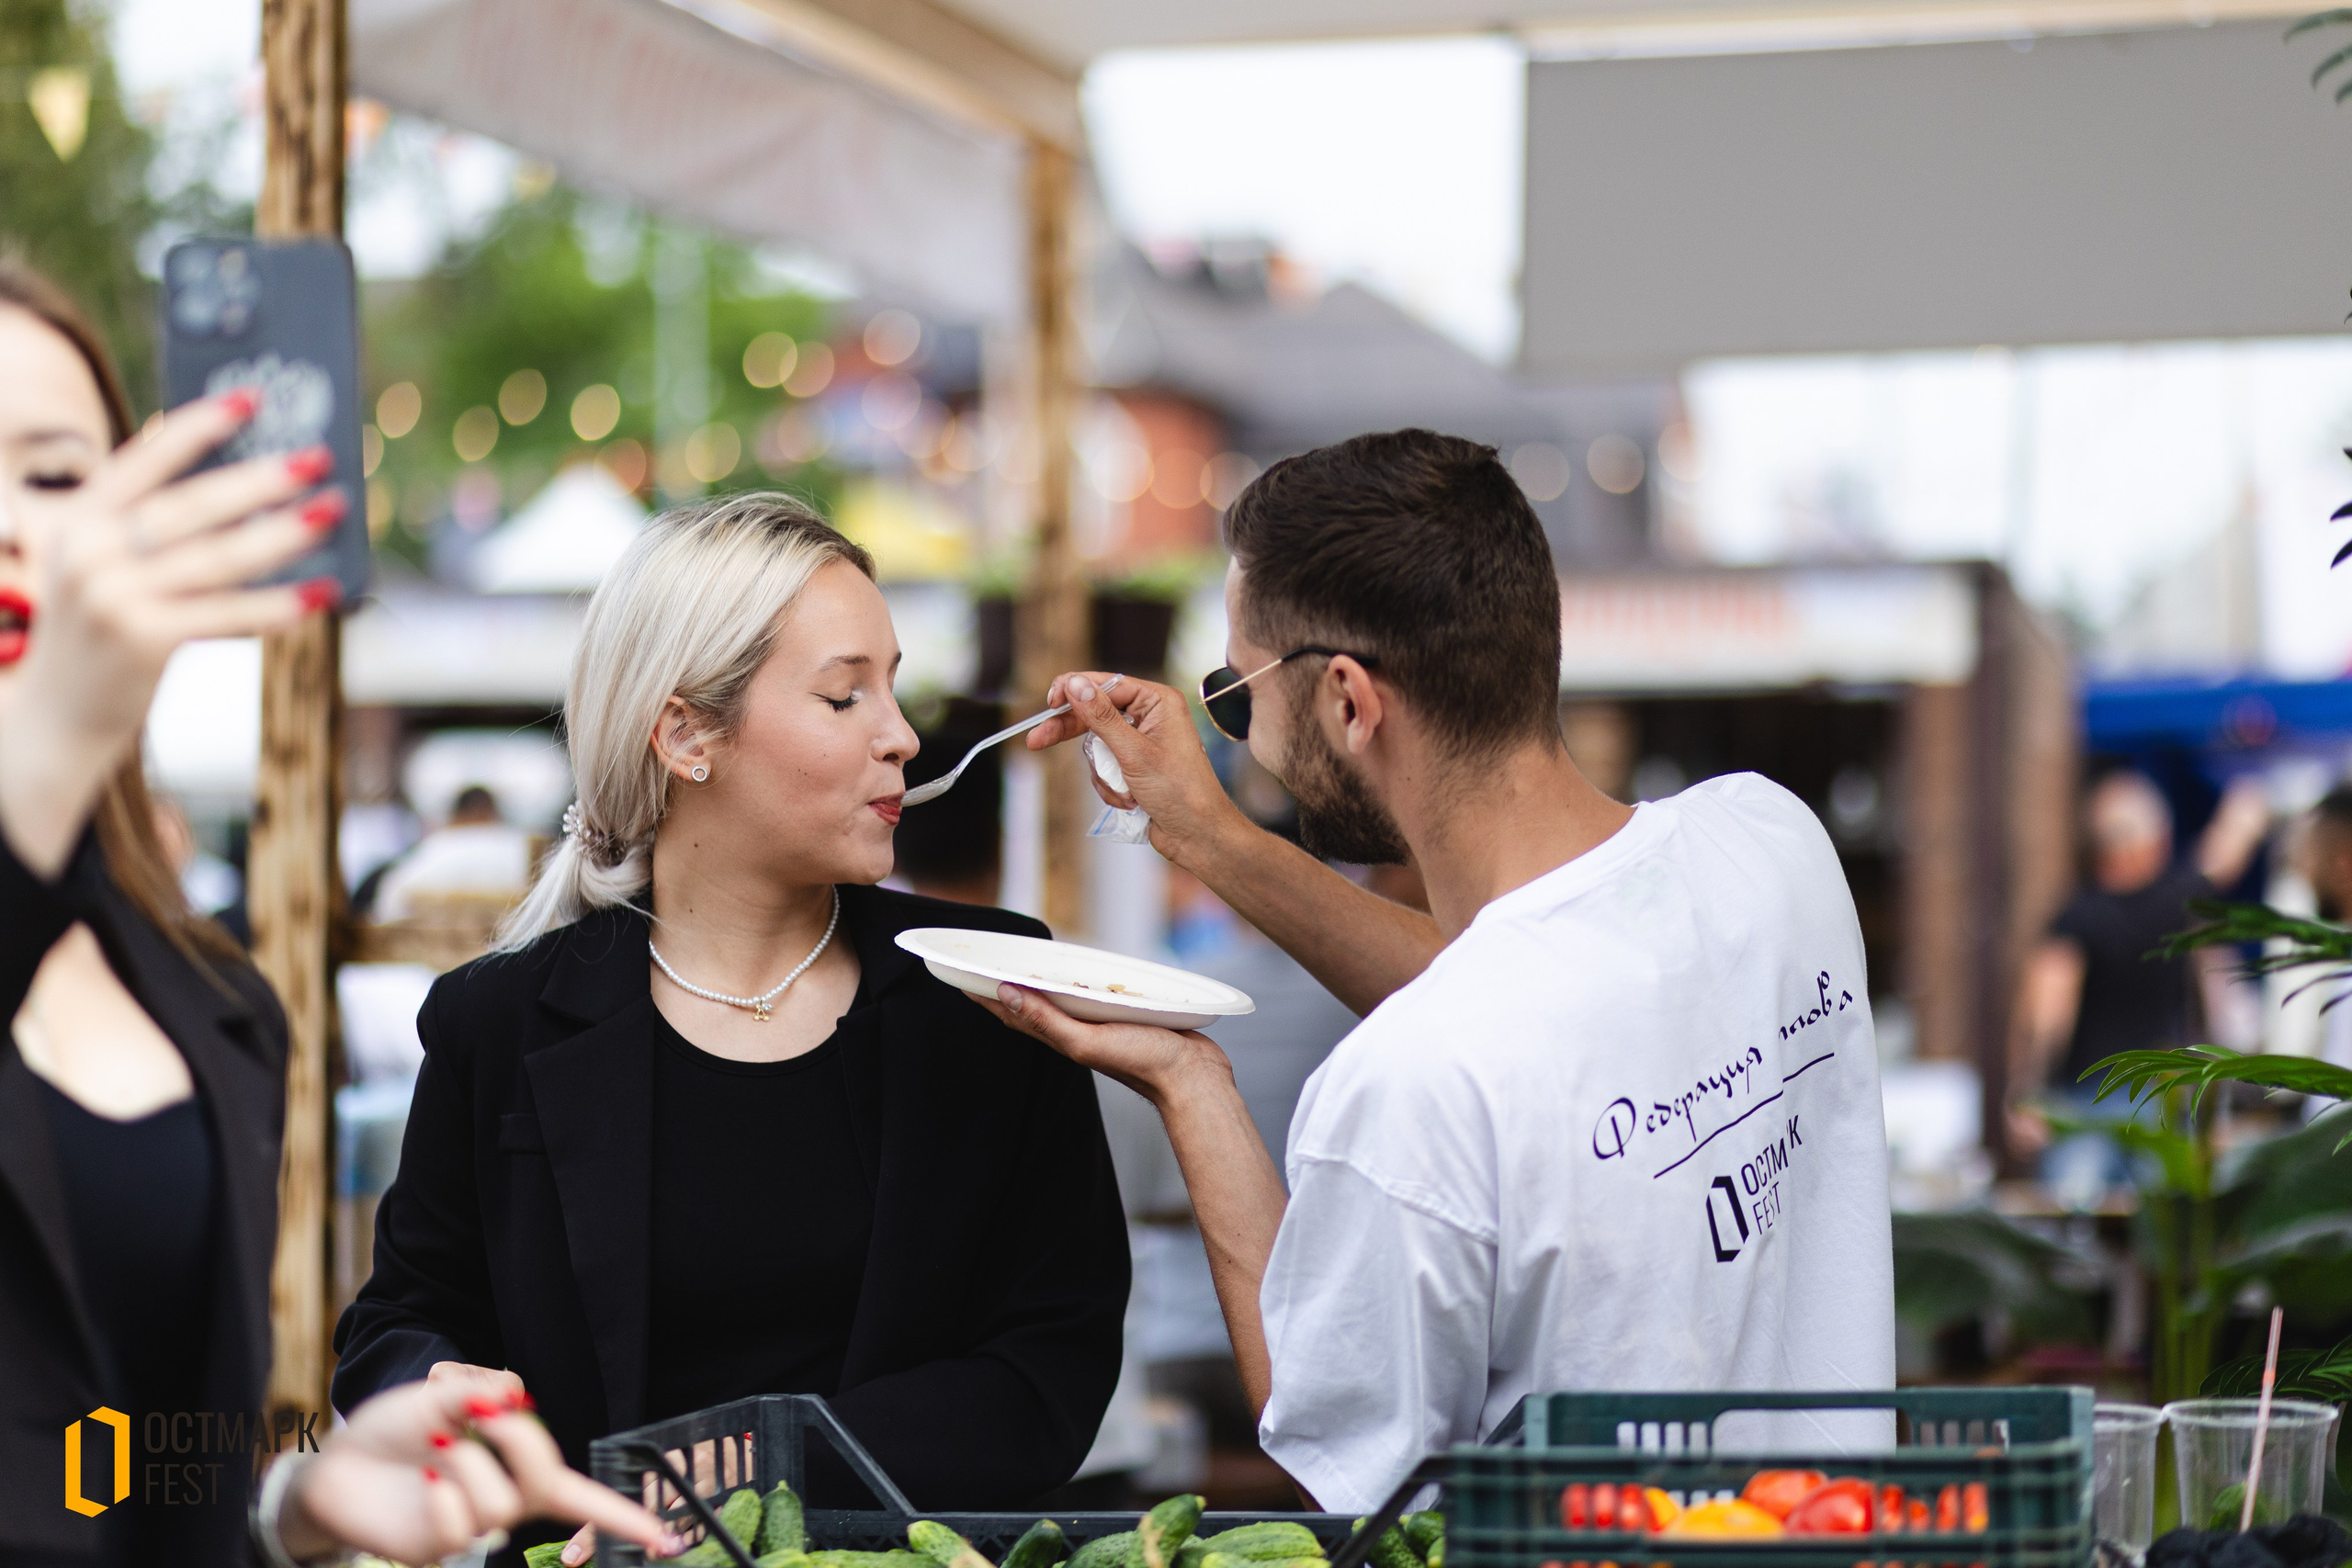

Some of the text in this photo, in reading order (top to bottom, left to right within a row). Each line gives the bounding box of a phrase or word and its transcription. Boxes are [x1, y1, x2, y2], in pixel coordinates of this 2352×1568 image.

[1592, 1046, 1763, 1160] Федерация
[1741, 1114, 1803, 1196] ОСТМК
[1752, 1181, 1781, 1235] FEST
